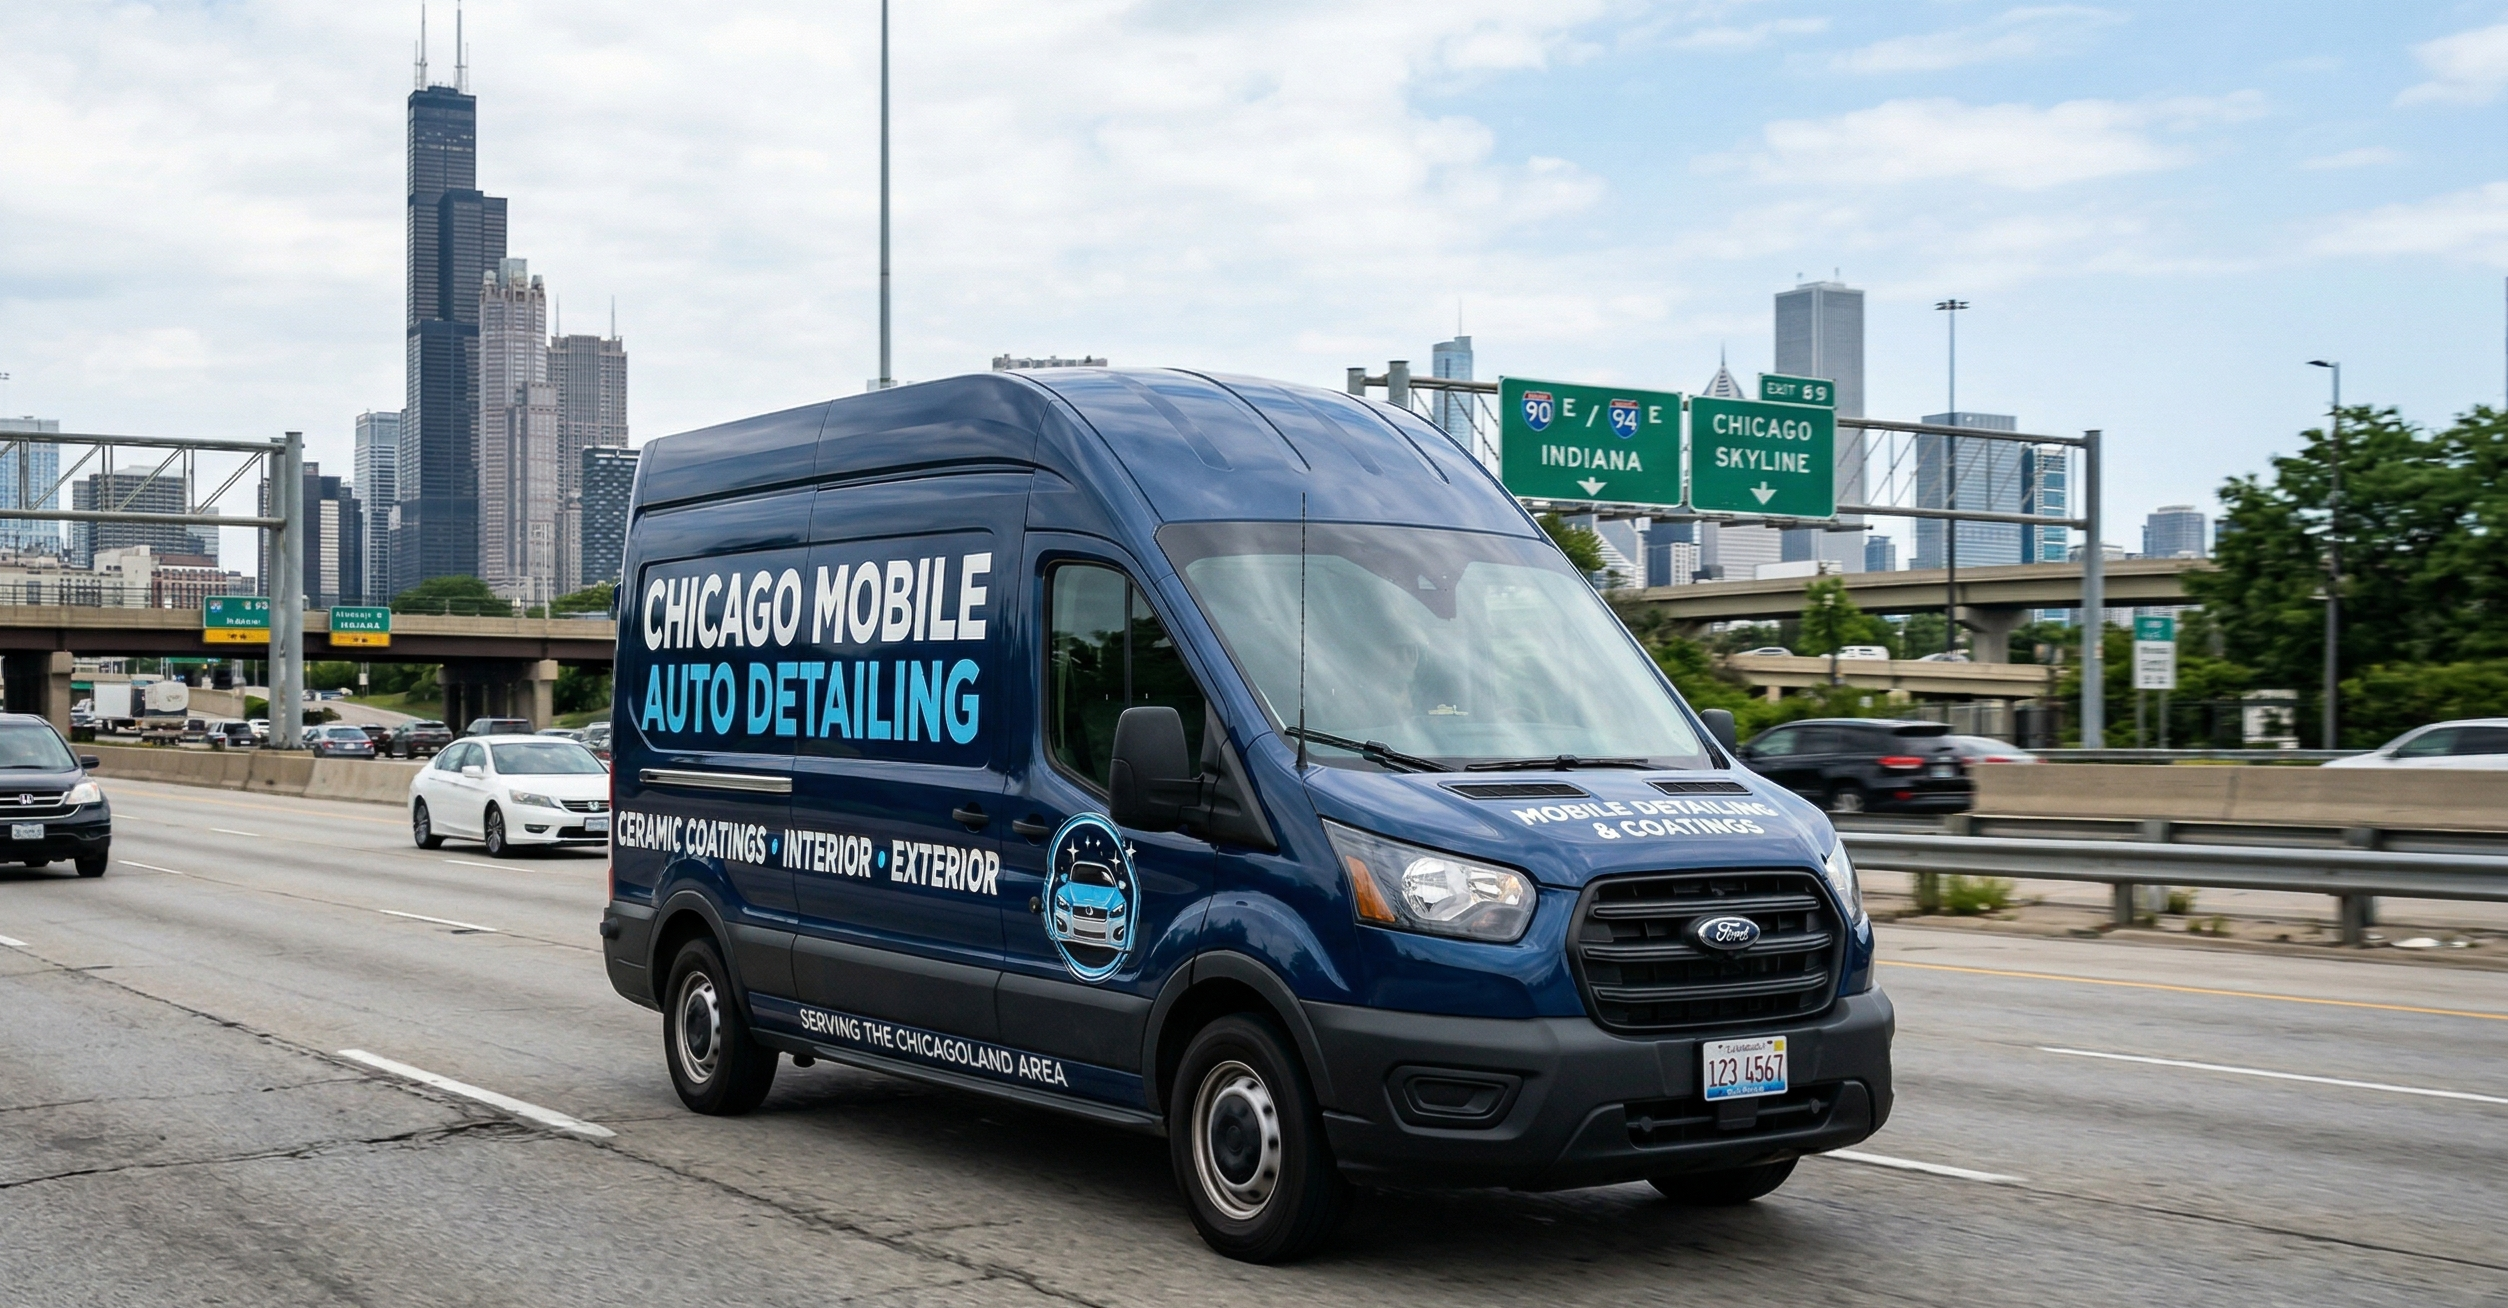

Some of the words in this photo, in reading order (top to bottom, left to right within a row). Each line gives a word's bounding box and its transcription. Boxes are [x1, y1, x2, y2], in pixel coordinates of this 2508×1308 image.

[1766, 382, 1796, 395] EXIT
[1526, 401, 1551, 423] 90
[1563, 398, 1577, 417] E
[1612, 409, 1637, 431] 94
[1649, 405, 1662, 424] E
[1712, 413, 1812, 441] CHICAGO
[1541, 444, 1643, 472] INDIANA
[1715, 446, 1811, 473] SKYLINE
[643, 567, 802, 651] CHICAGO
[812, 551, 993, 645] MOBILE
[641, 661, 736, 735] AUTO
[747, 658, 980, 744] DETAILING
[1511, 801, 1634, 826] MOBILE
[1630, 800, 1779, 817] DETAILING
[1592, 822, 1621, 840] &
[1619, 818, 1765, 838] COATINGS
[617, 810, 682, 854] CERAMIC
[685, 817, 767, 865] COATINGS
[782, 828, 872, 879] INTERIOR
[891, 839, 1000, 896] EXTERIOR
[1716, 921, 1750, 942] Ford
[800, 1008, 861, 1041] SERVING
[863, 1021, 894, 1048] THE
[896, 1028, 1013, 1074] CHICAGOLAND
[1019, 1054, 1069, 1087] AREA
[1709, 1057, 1737, 1087] 123
[1745, 1053, 1784, 1083] 4567
